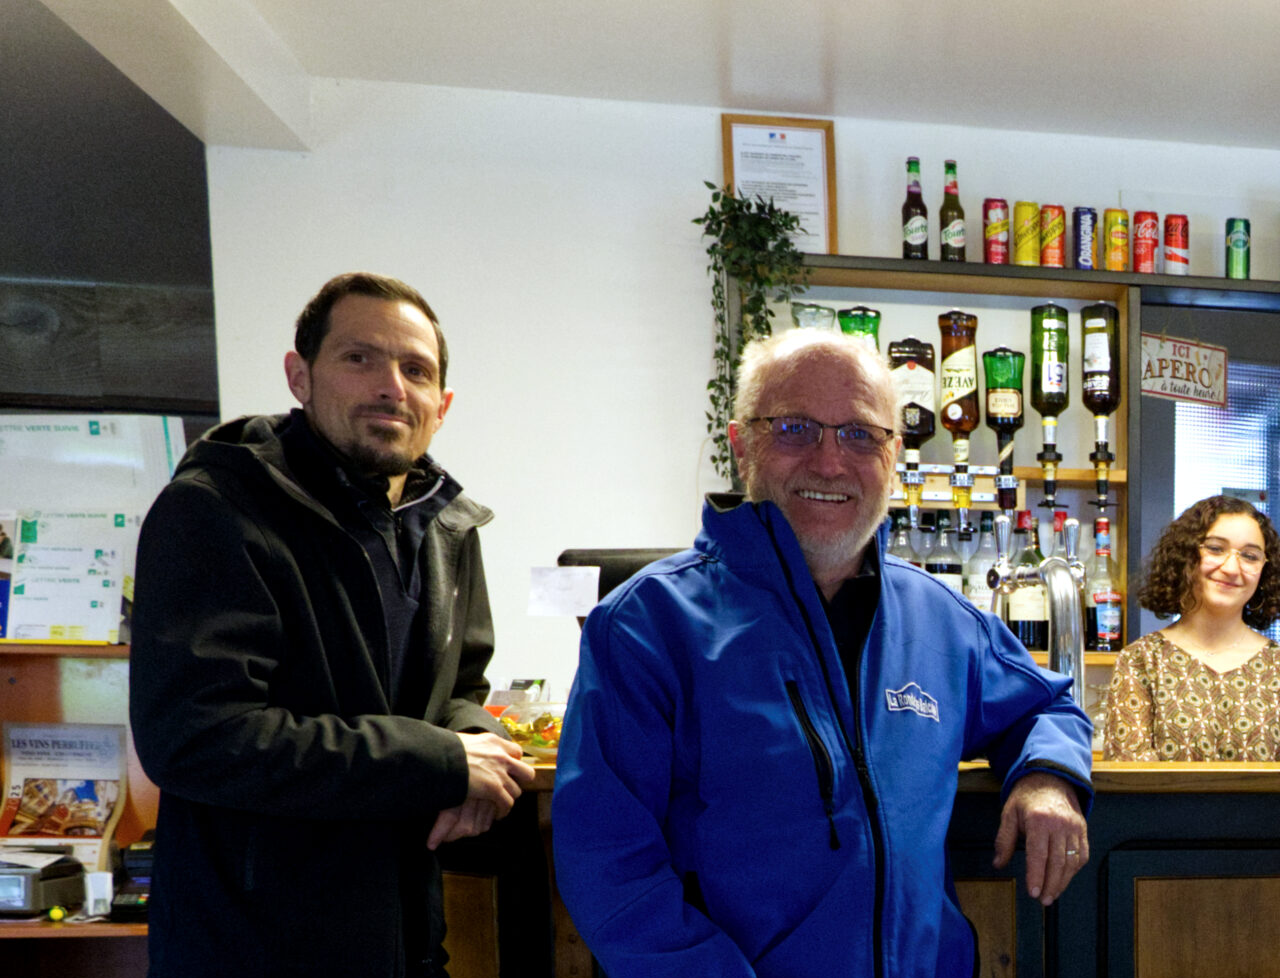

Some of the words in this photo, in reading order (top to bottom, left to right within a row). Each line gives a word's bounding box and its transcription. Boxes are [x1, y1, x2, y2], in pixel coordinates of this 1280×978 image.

[1172, 343, 1191, 359] ICI
[1142, 358, 1212, 388] APERO
[1170, 381, 1191, 395] toute
